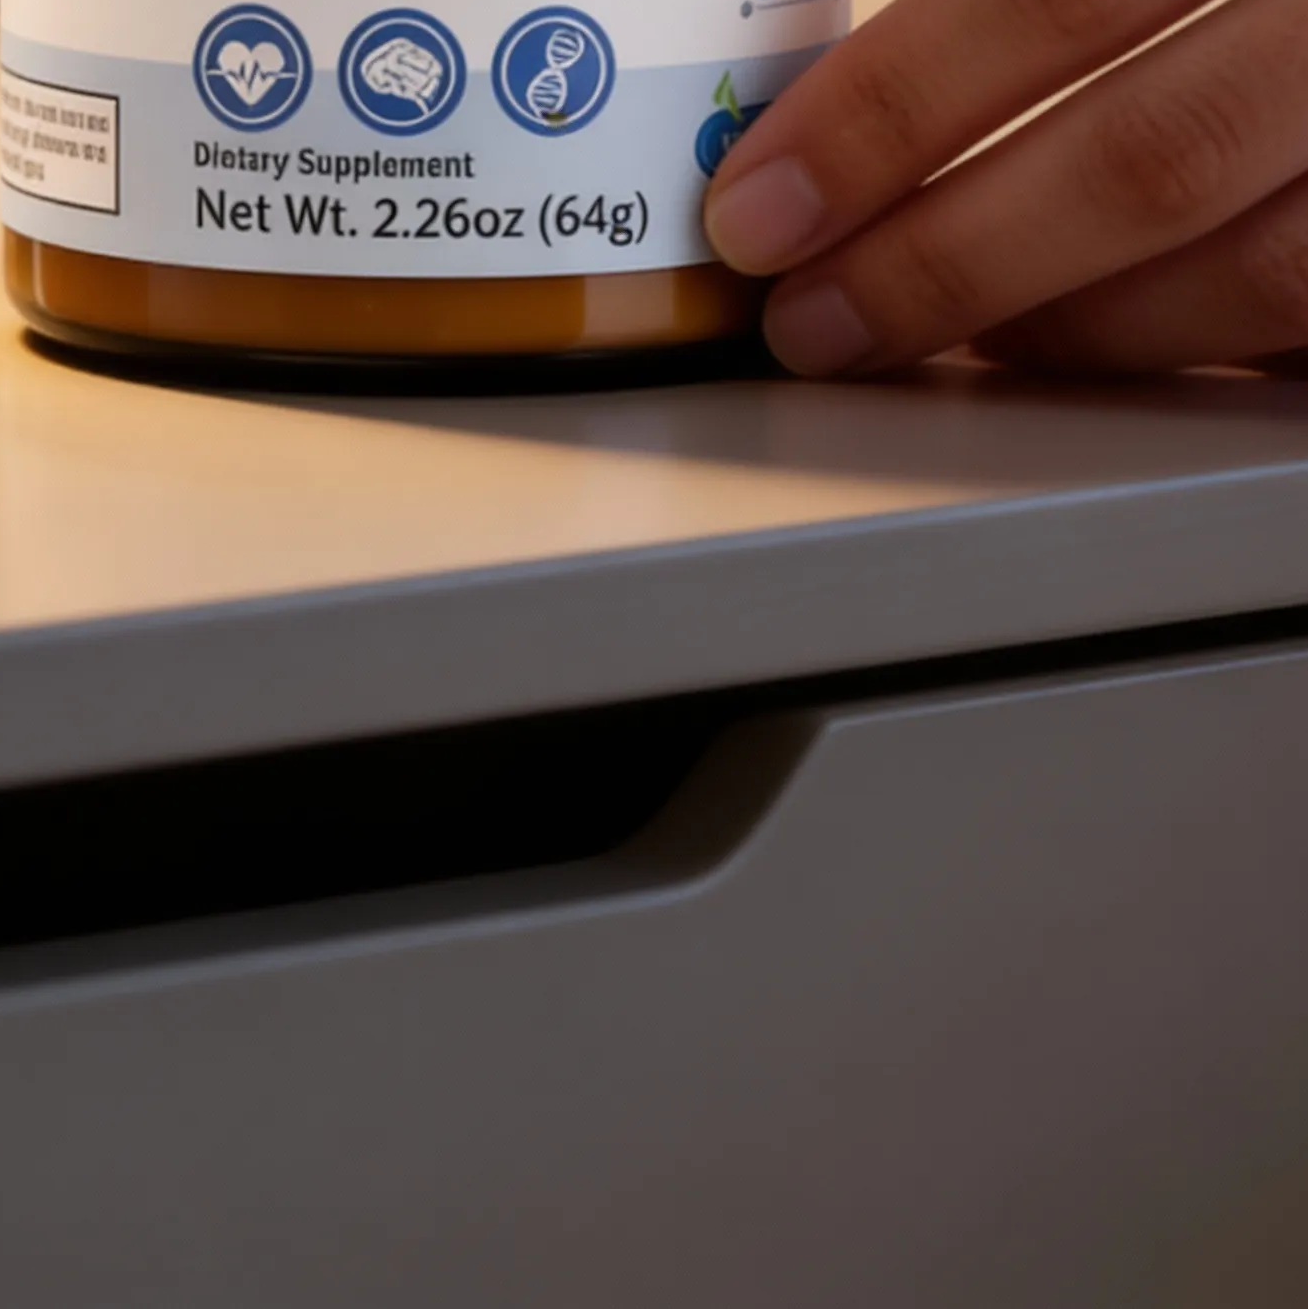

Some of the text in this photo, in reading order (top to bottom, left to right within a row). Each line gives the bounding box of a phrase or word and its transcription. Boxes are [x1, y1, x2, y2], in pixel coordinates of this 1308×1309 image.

[194, 141, 476, 185] Dietary Supplement
[196, 186, 649, 248] Net Wt. 2.26oz (64g)
